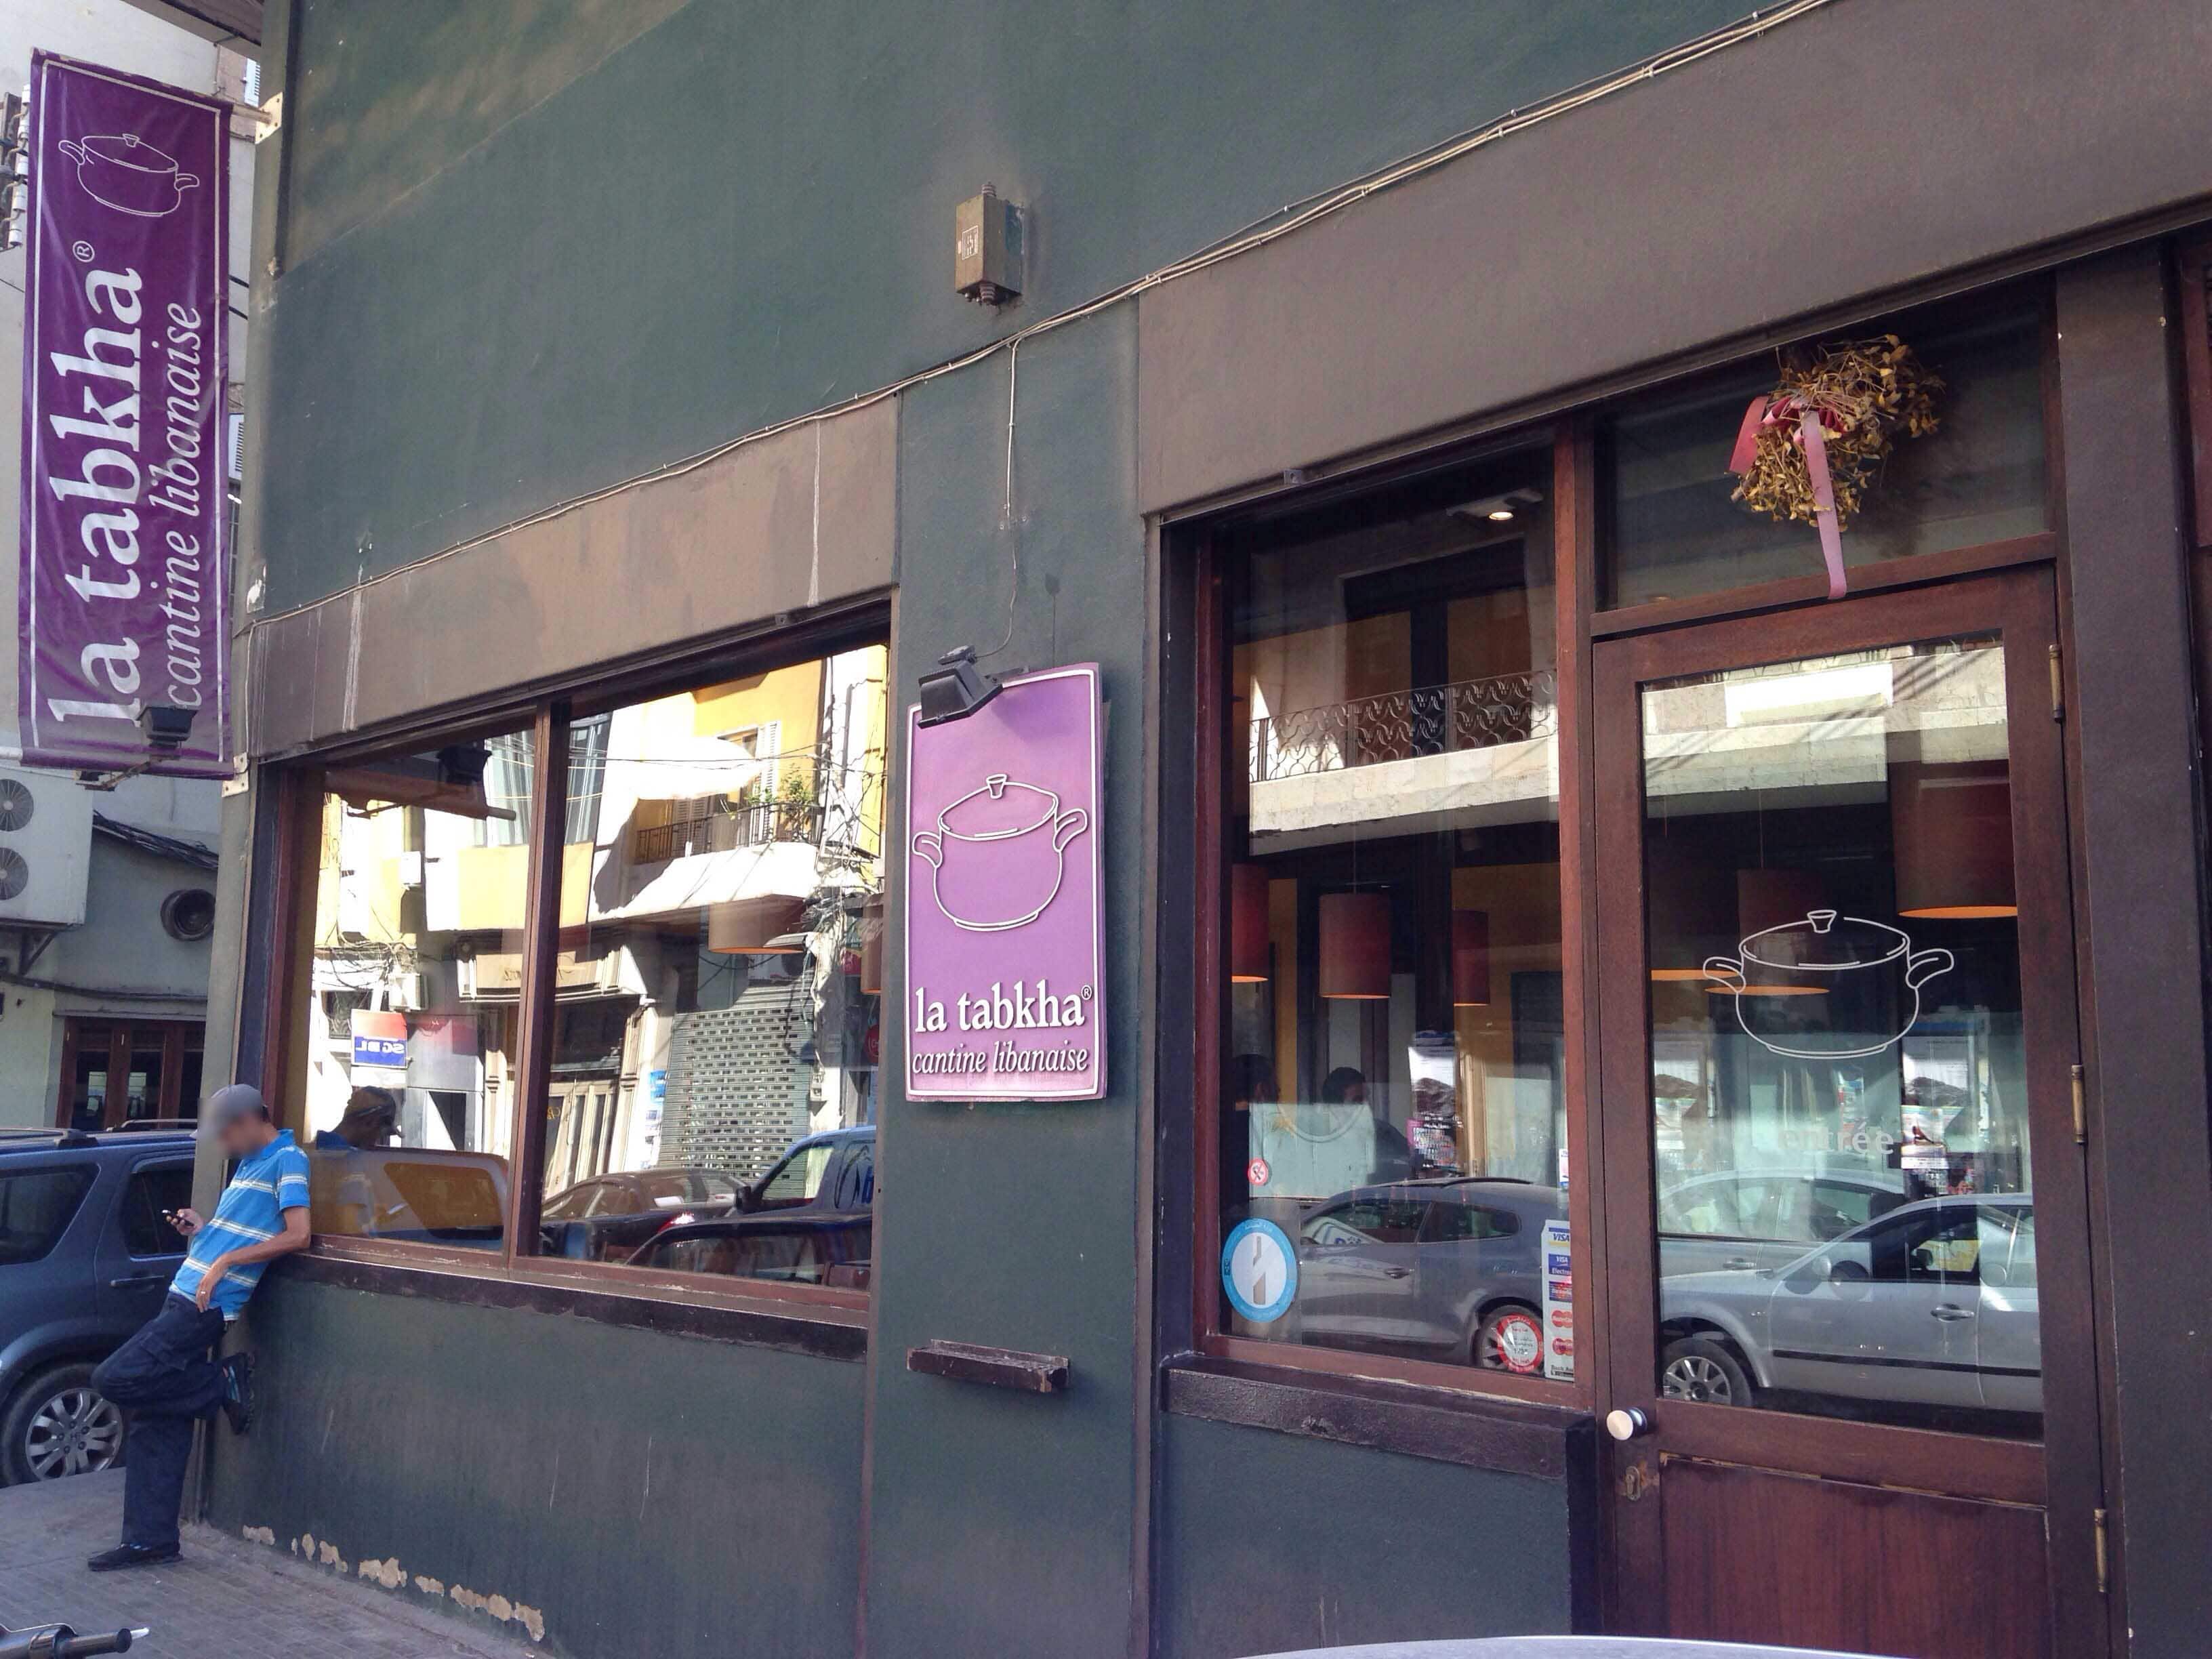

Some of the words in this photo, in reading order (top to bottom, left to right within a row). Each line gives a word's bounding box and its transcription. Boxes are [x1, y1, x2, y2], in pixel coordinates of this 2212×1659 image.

[147, 303, 201, 517] libanaise
[150, 531, 202, 710] cantine
[48, 636, 141, 727] la
[915, 987, 947, 1033] la
[912, 1043, 987, 1073] cantine
[992, 1040, 1088, 1073] libanaise
[1553, 1233, 1570, 1242] VISA
